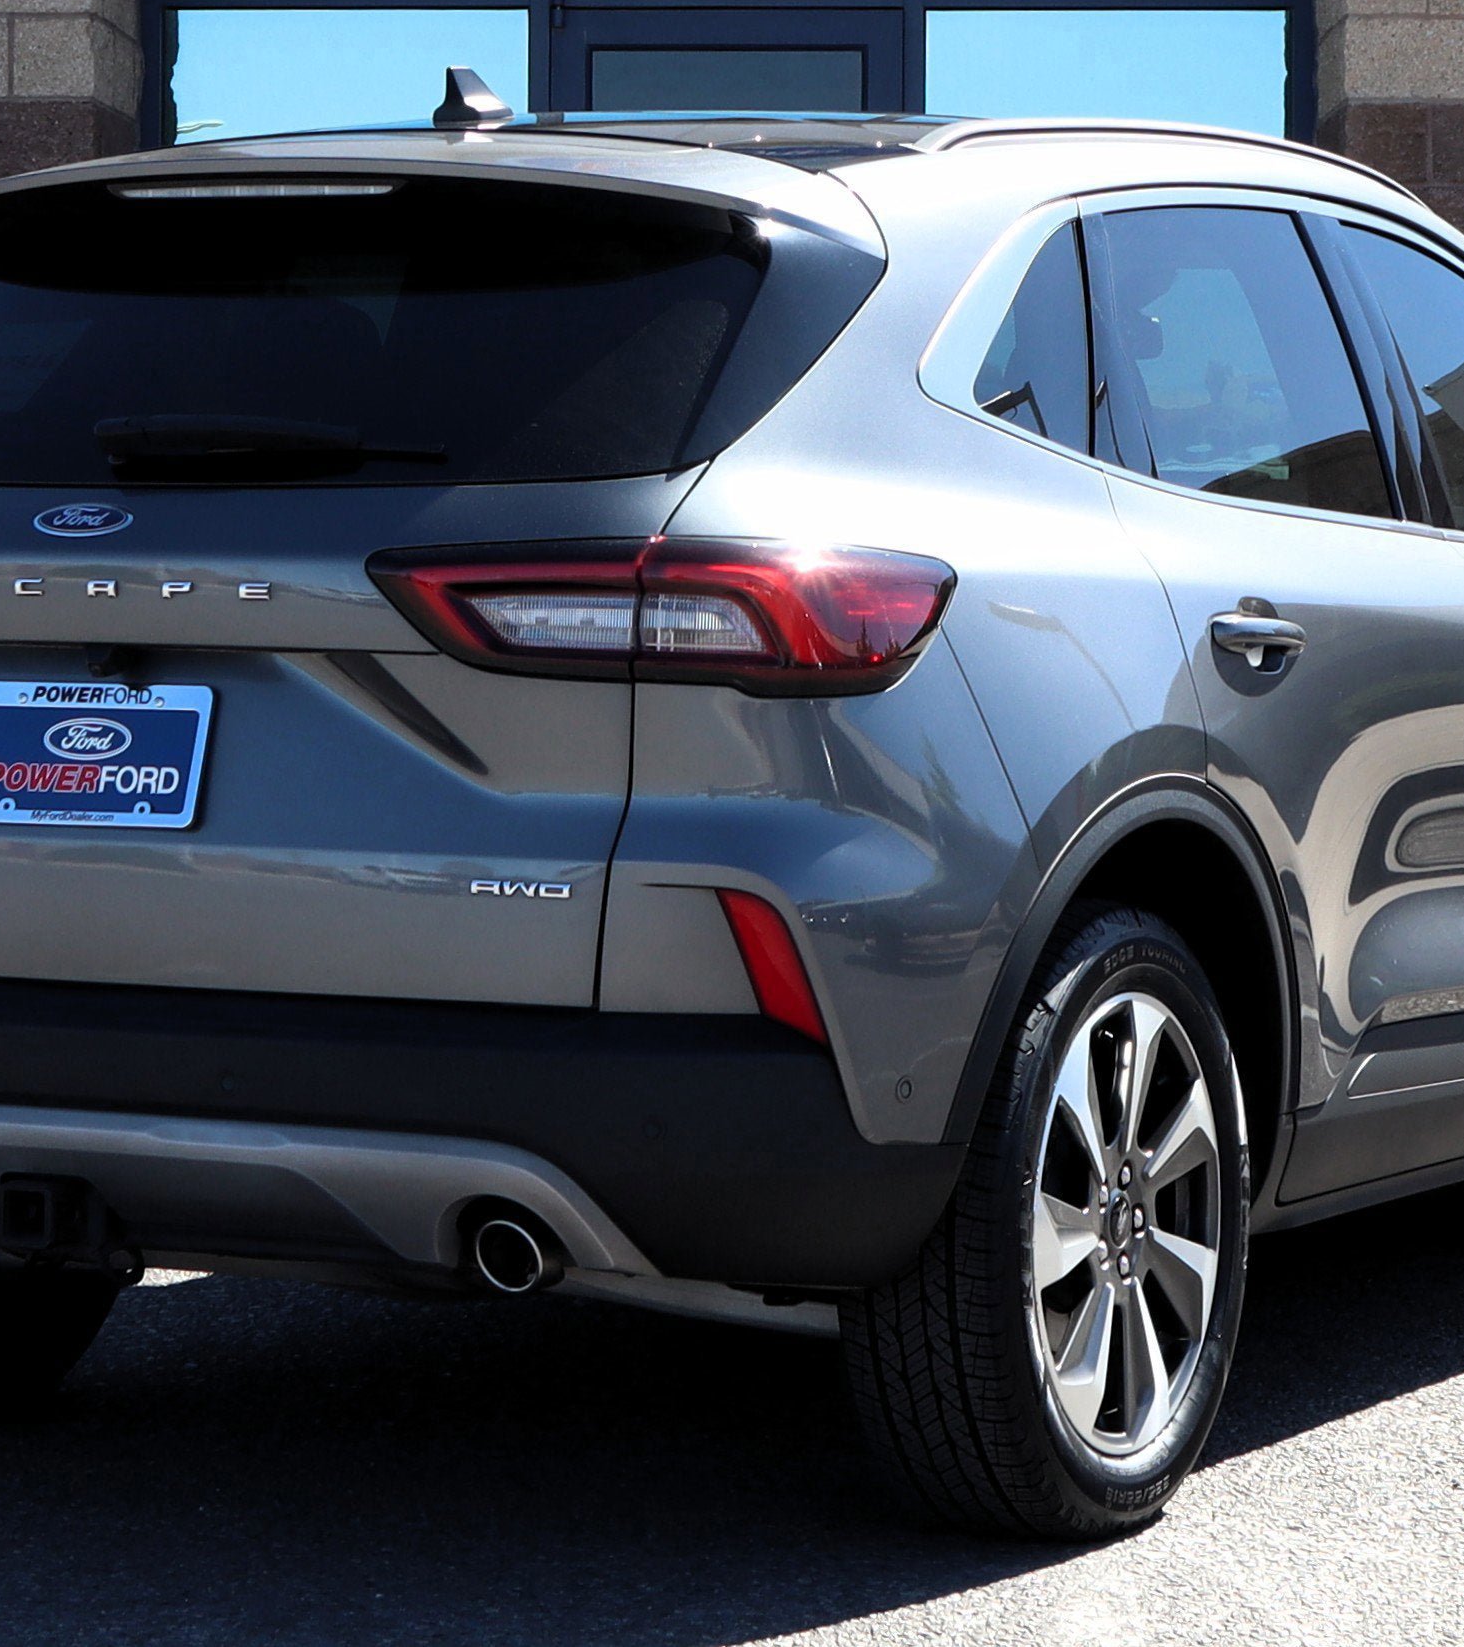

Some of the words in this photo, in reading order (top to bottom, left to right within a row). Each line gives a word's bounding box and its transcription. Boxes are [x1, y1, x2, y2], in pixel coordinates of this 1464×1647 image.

[53, 506, 109, 529] Ford
[32, 685, 153, 705] POWERFORD
[60, 725, 114, 751] Ford
[30, 809, 115, 823] MyFordDealer.com
[470, 879, 572, 899] AWD
